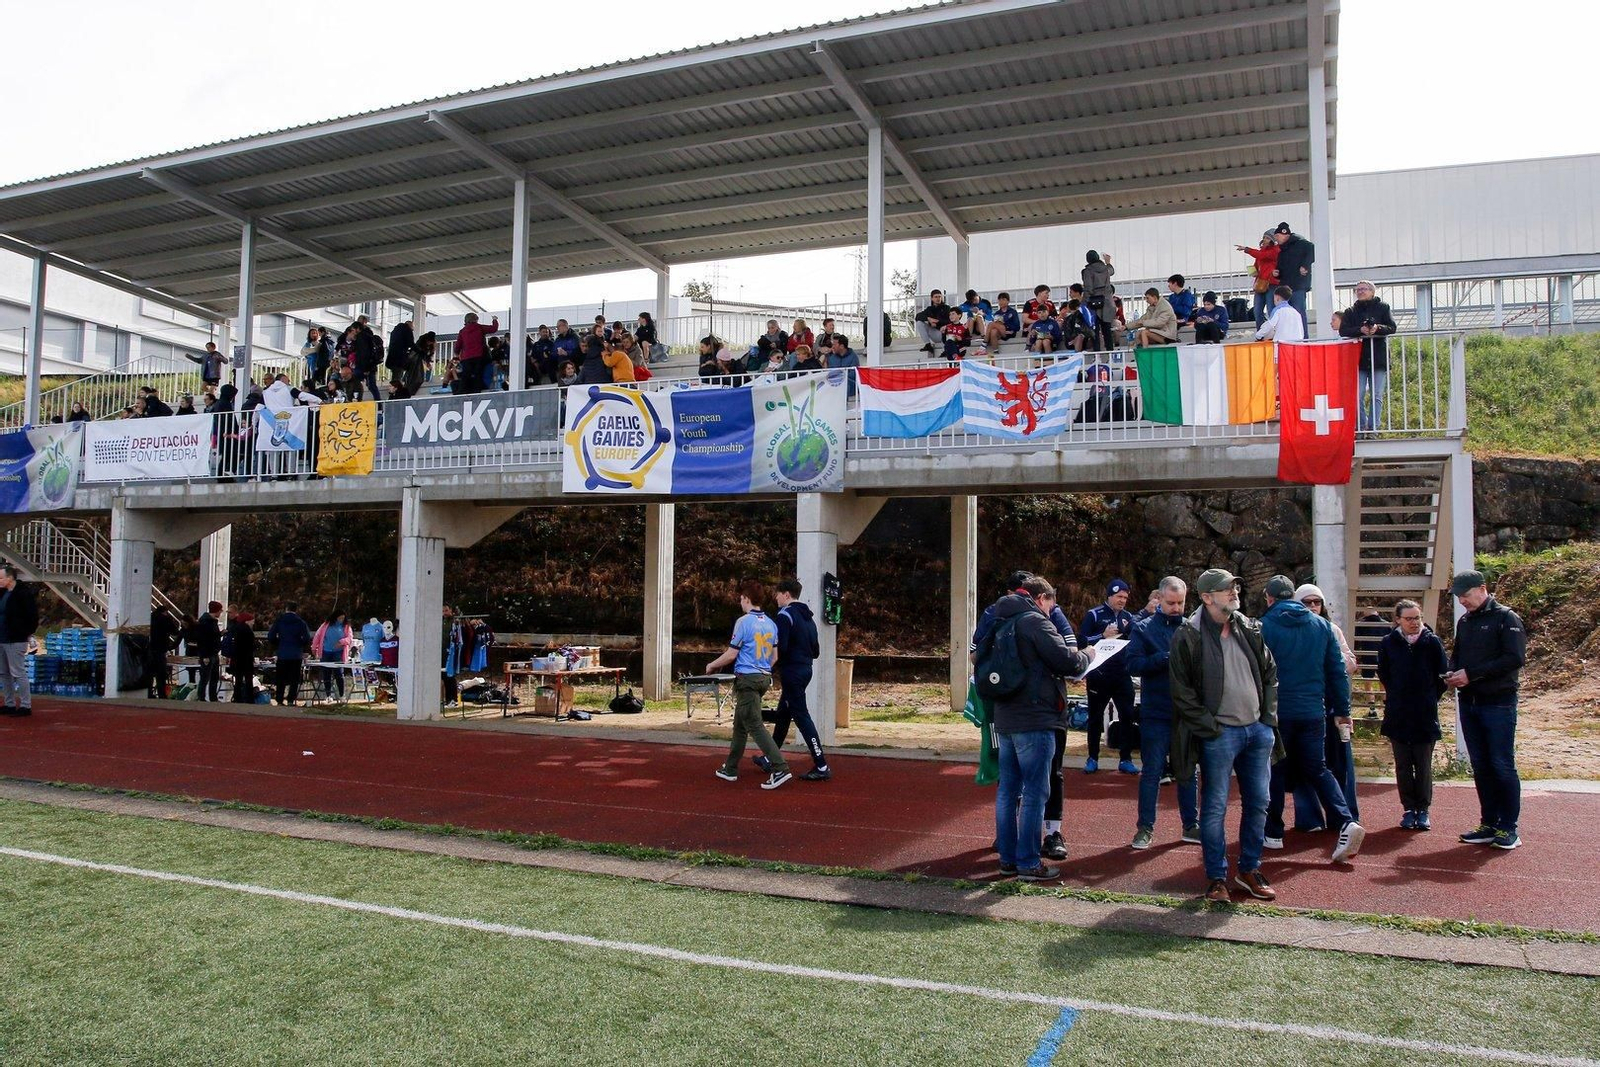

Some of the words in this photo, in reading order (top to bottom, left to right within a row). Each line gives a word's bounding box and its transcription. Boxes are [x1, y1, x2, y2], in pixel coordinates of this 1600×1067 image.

[401, 400, 533, 444] McKvr
[597, 415, 641, 430] GAELIC
[679, 413, 721, 425] European
[131, 431, 199, 450] DEPUTACIÓN
[592, 430, 645, 447] GAMES
[680, 428, 707, 438] Youth
[766, 423, 790, 458] GLOBAL
[814, 418, 838, 446] GAMES
[130, 447, 198, 462] PONTEVEDRA
[594, 448, 640, 460] EUROPE
[681, 441, 745, 455] Championship
[770, 471, 823, 492] DEVELOPMENT
[823, 458, 838, 481] FUND
